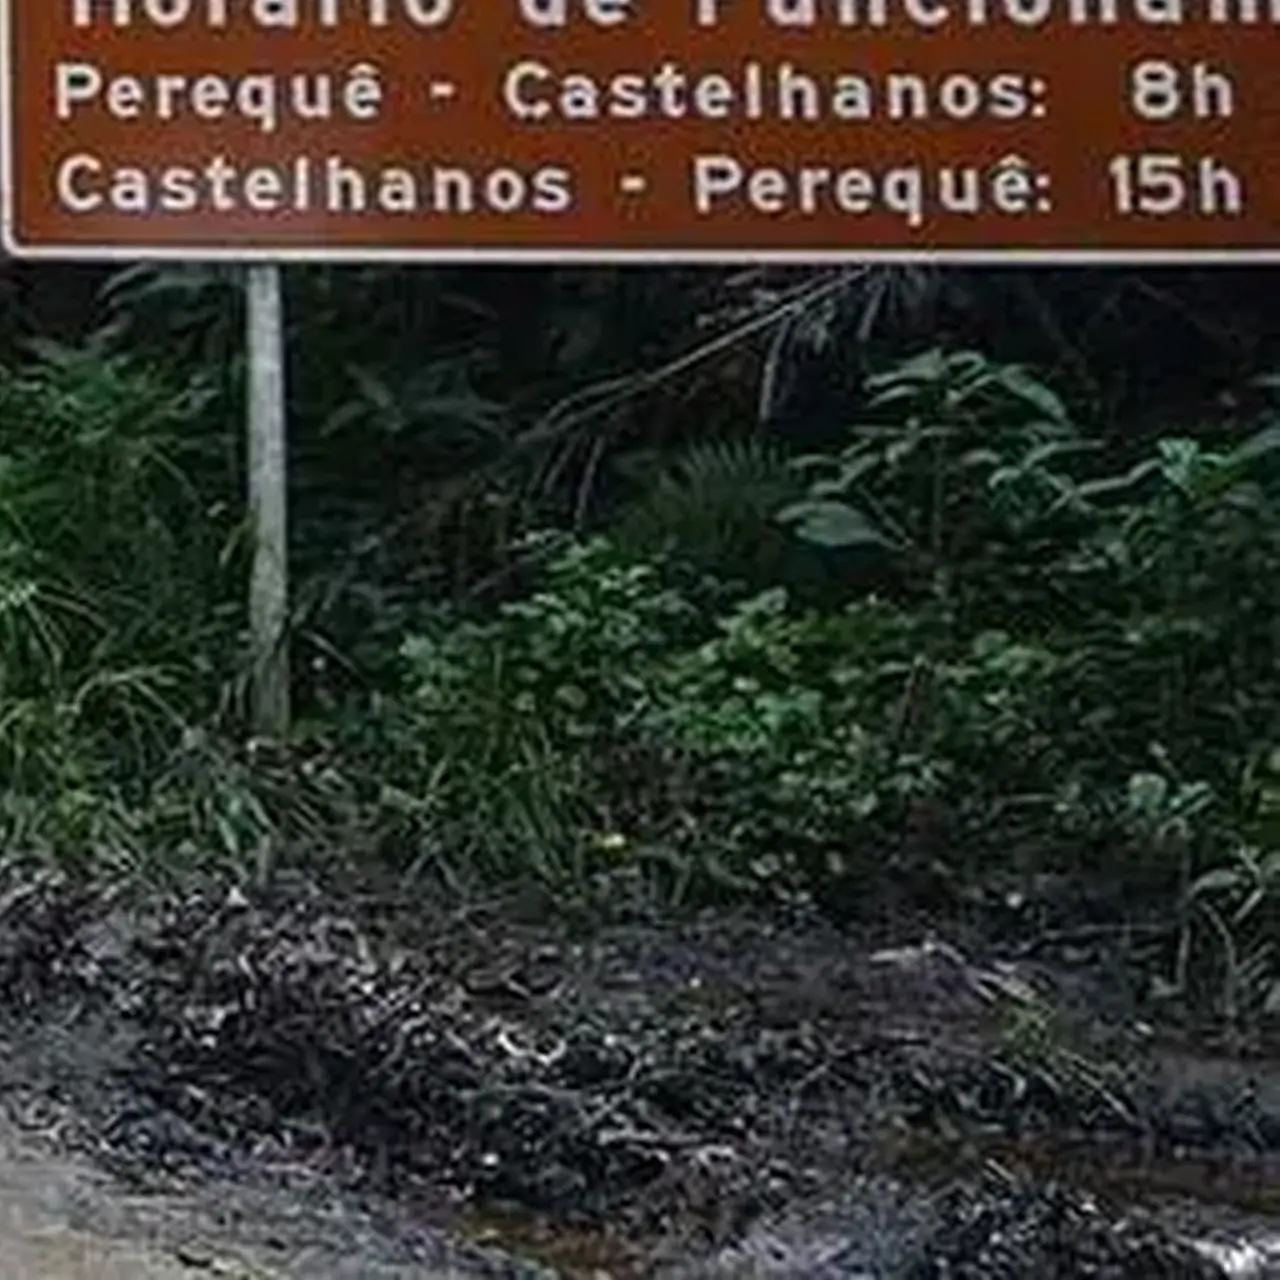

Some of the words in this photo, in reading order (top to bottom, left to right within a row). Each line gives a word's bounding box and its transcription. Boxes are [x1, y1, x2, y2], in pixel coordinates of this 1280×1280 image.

[54, 61, 382, 132] Perequê
[430, 82, 455, 99] -
[503, 60, 1047, 120] Castelhanos:
[1132, 59, 1235, 120] 8h
[56, 153, 572, 212] Castelhanos
[621, 176, 646, 193] -
[694, 153, 1053, 228] Perequê:
[1108, 154, 1241, 215] 15h
